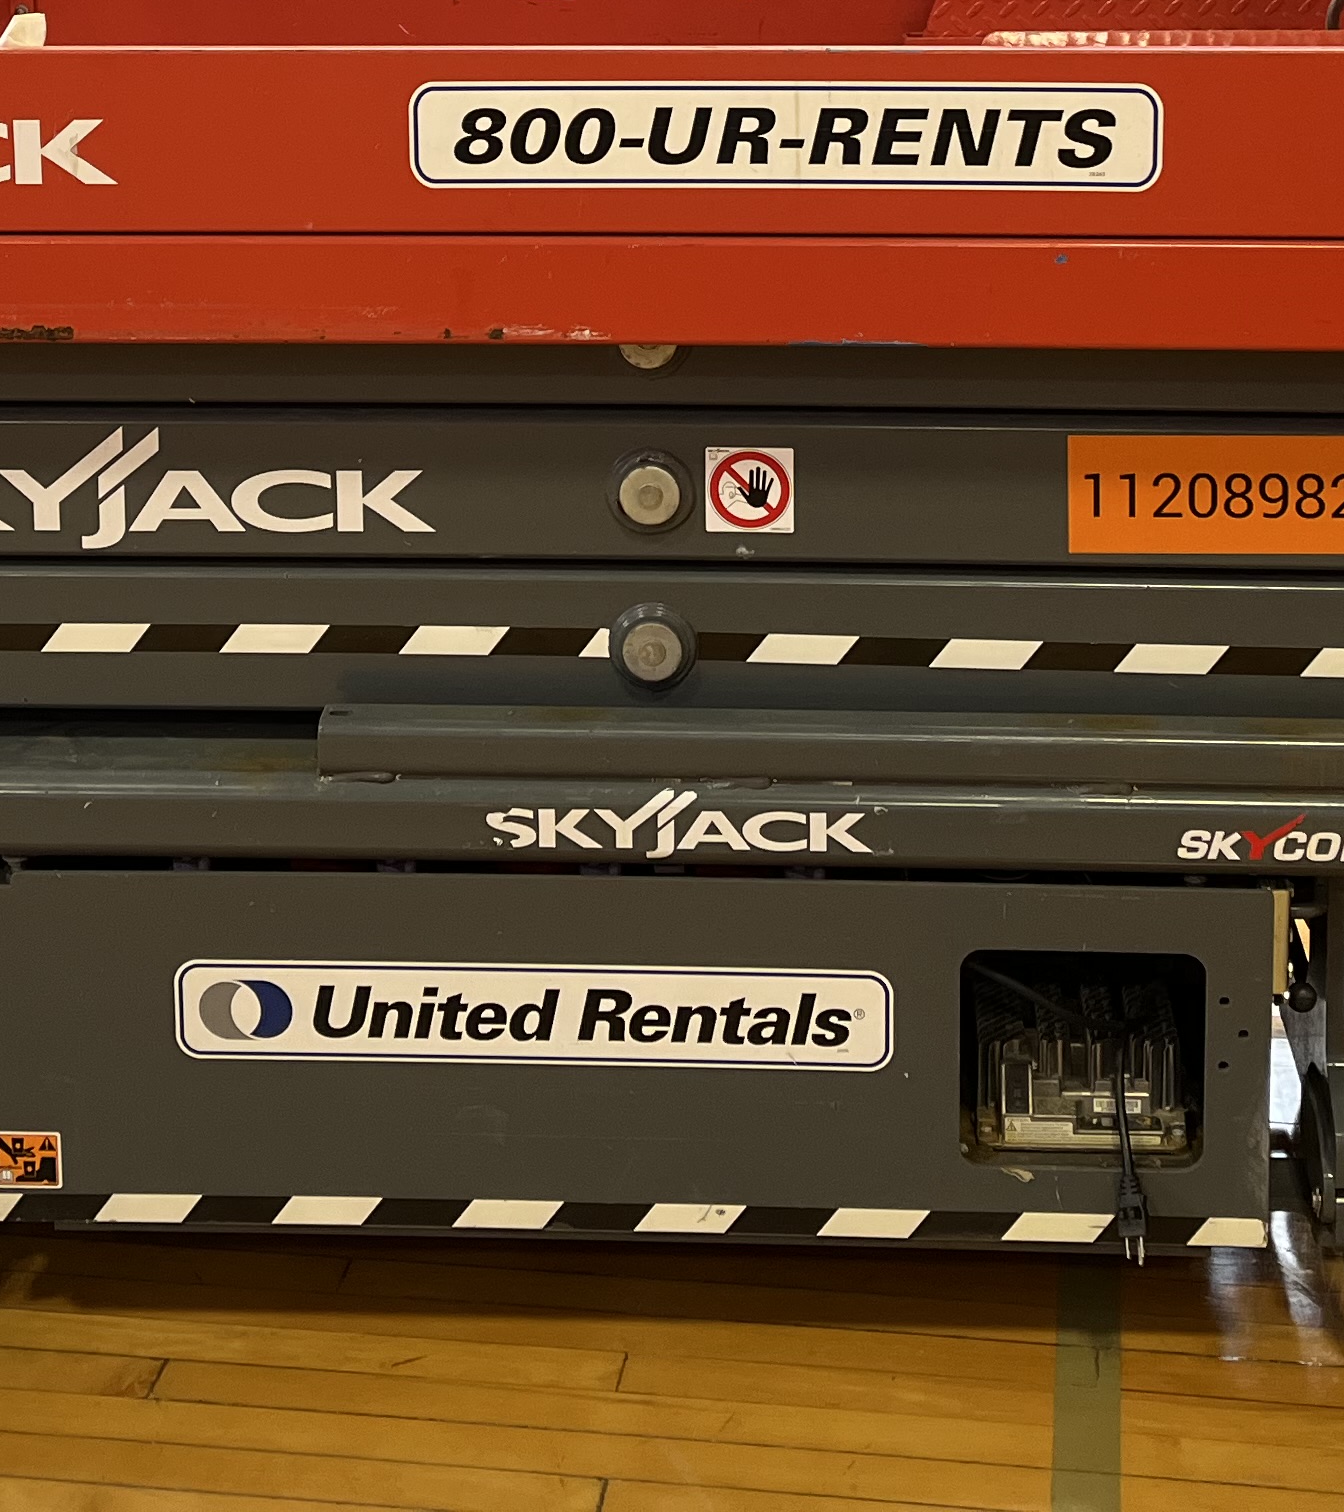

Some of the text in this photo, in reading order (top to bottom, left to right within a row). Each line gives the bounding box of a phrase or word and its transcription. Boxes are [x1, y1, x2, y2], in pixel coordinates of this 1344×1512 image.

[453, 107, 1118, 169] 800-UR-RENTS
[485, 788, 873, 859] SKYJACK
[311, 984, 561, 1042] United
